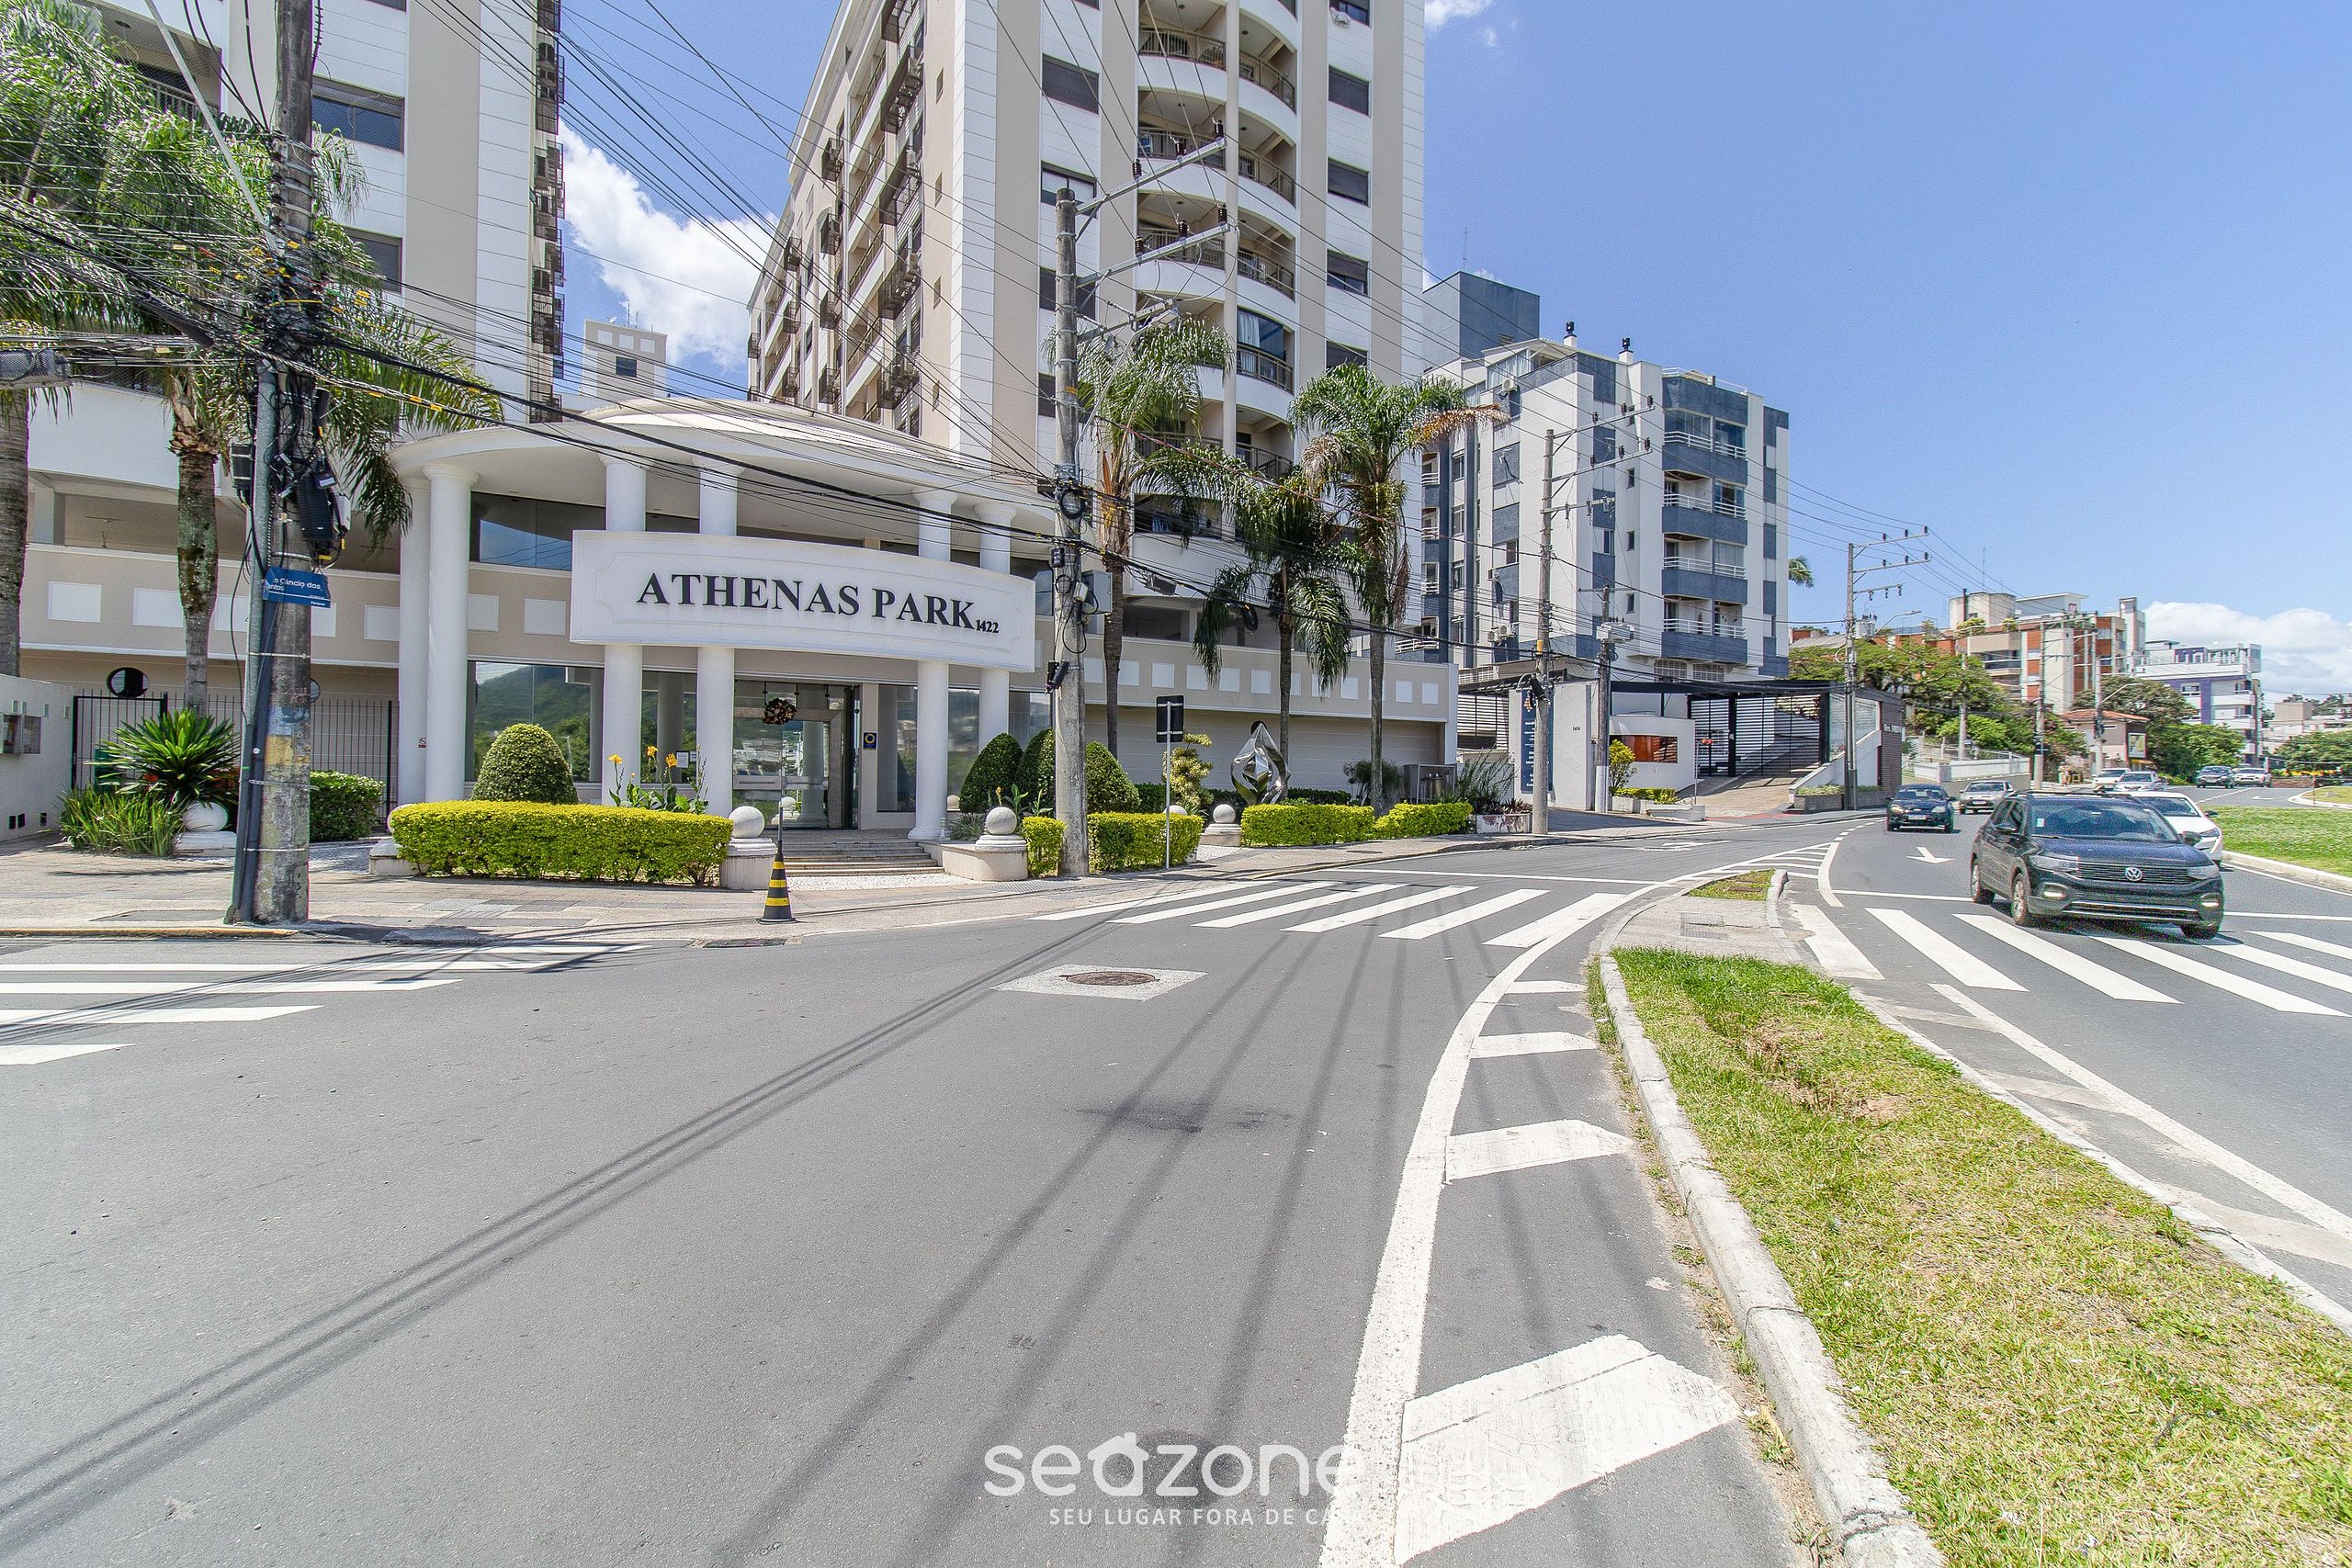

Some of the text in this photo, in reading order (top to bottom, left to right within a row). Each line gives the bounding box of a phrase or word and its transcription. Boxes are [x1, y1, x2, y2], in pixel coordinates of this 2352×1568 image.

[636, 571, 977, 630] ATHENAS PARK
[976, 618, 1000, 635] 1422
